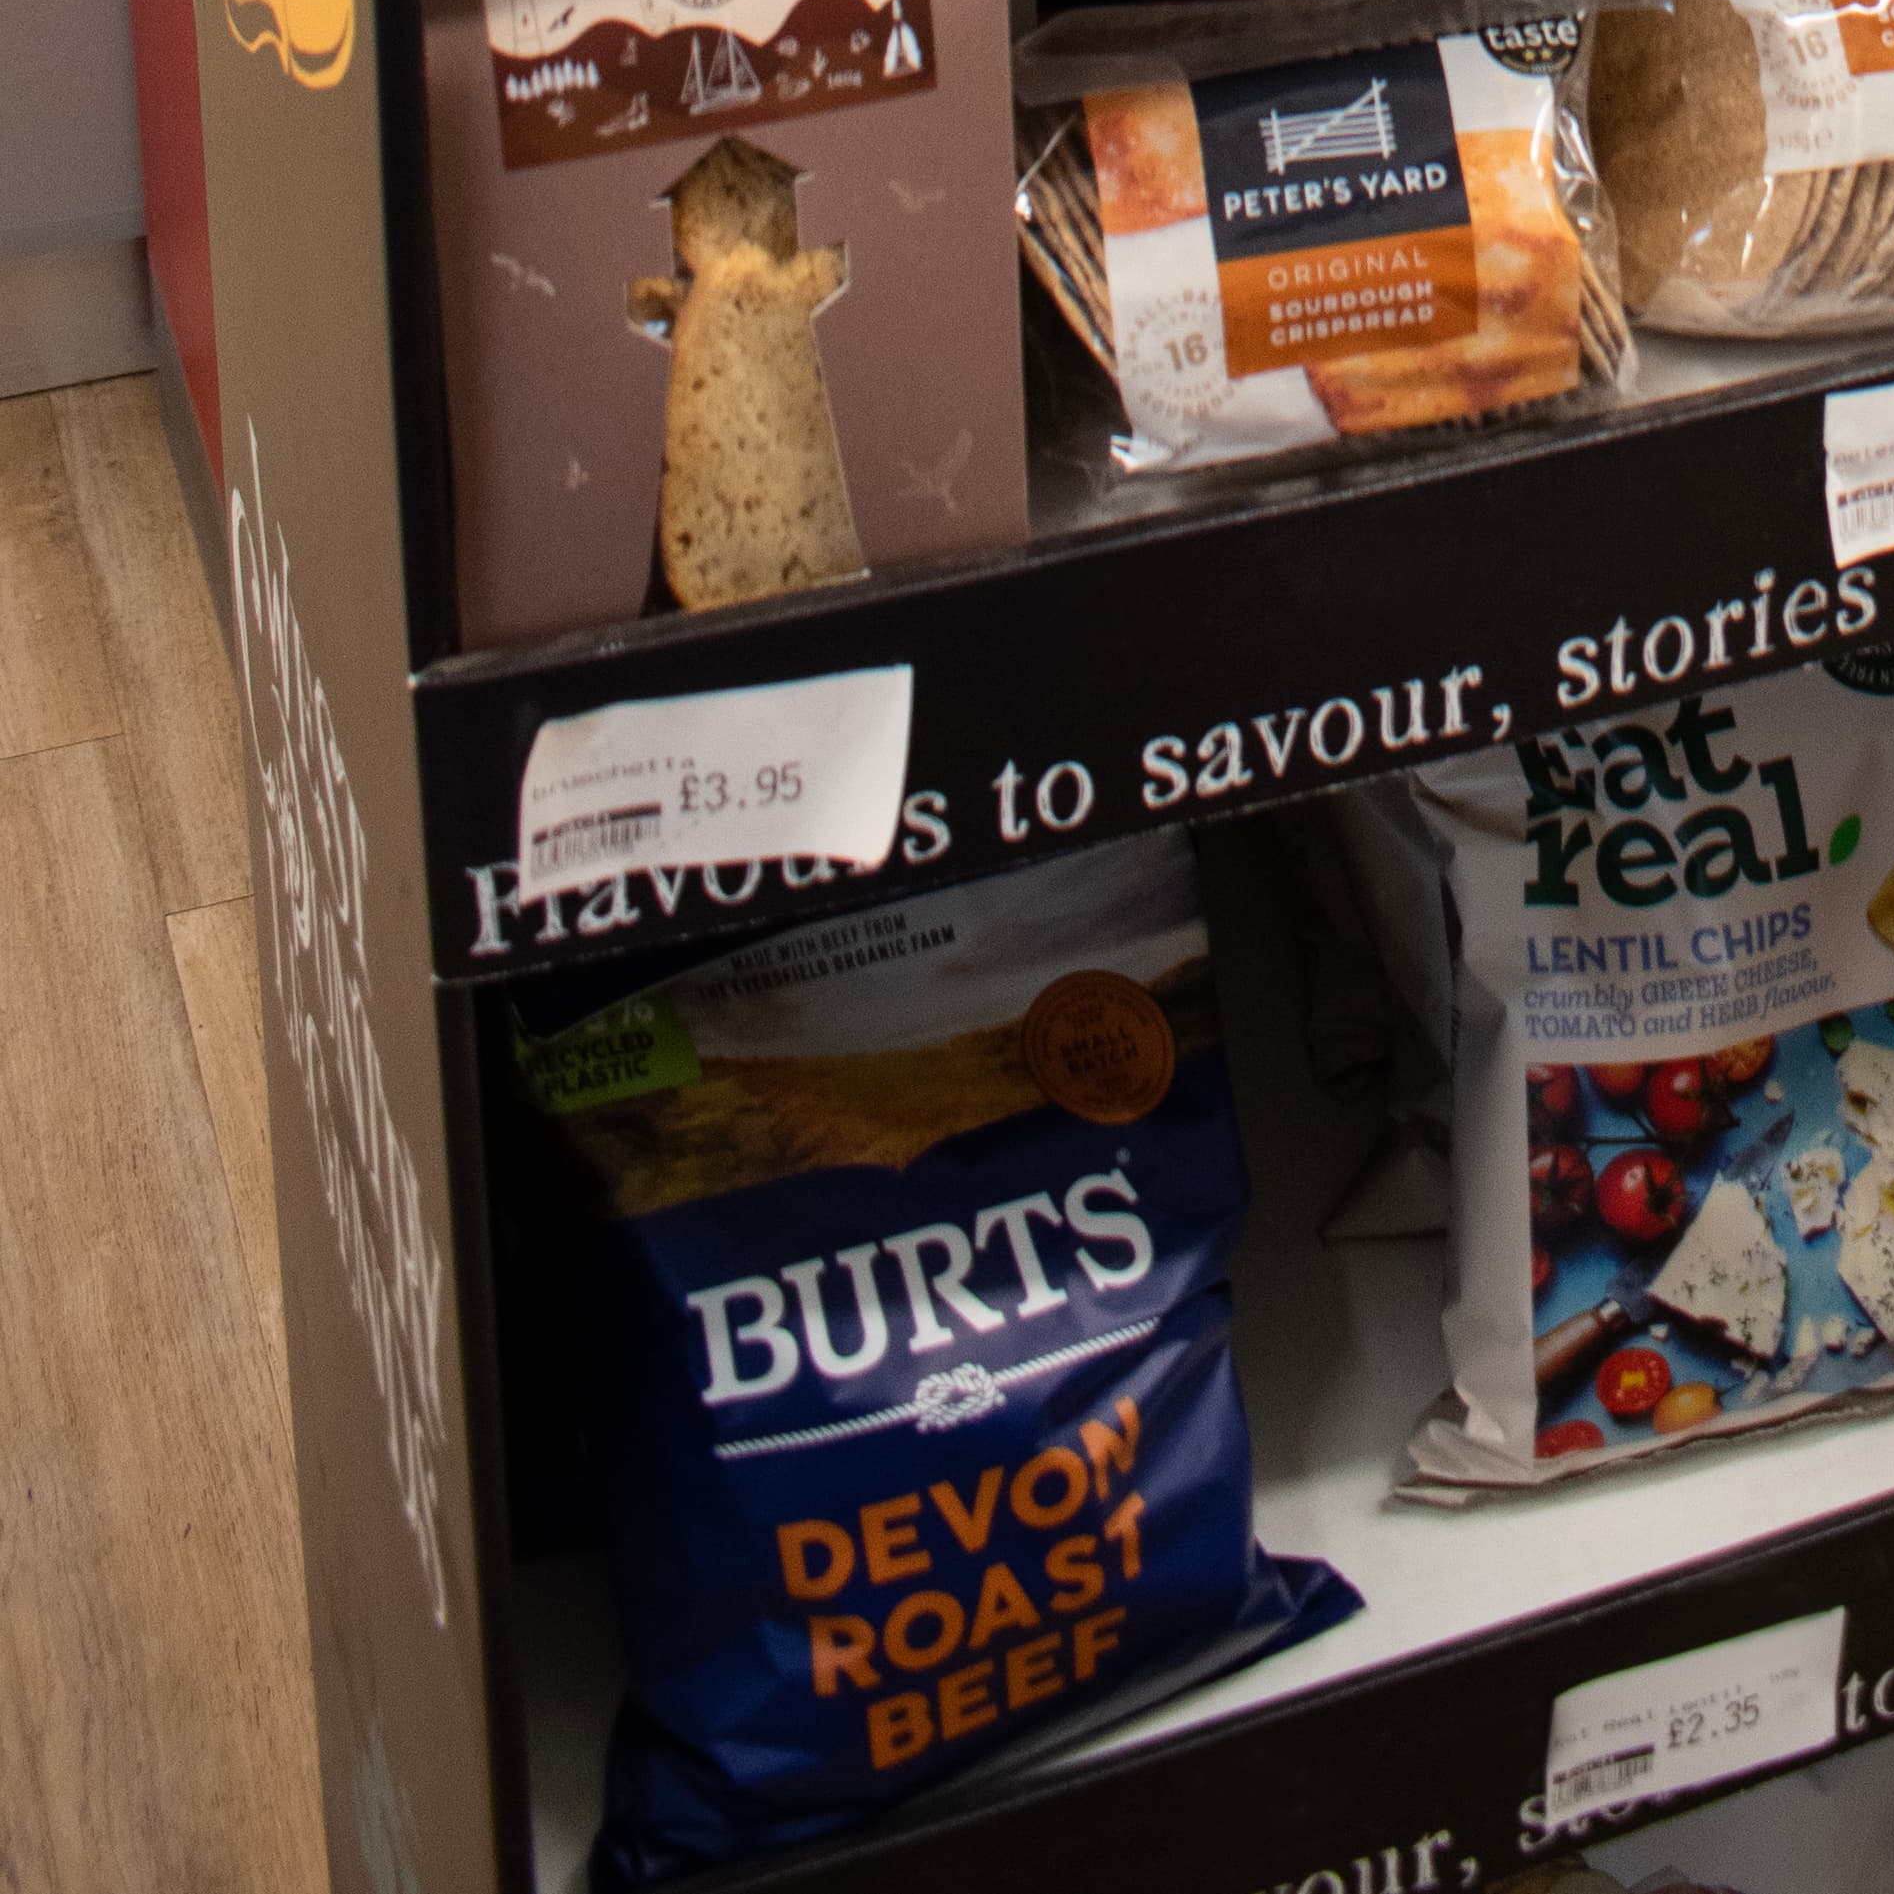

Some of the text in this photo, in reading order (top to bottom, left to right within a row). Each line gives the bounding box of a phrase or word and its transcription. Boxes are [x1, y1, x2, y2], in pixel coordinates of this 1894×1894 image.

[1486, 15, 1577, 51] taste
[1222, 163, 1448, 222] PETER'S YARD
[1266, 247, 1430, 292] ORIGINAL
[1269, 280, 1435, 324] SOURDOUGH
[1269, 304, 1436, 346] CRISPBREAD
[992, 759, 1095, 842] to
[1140, 665, 1514, 808] savour,
[1556, 567, 1878, 708] stories
[1517, 696, 1752, 817] Eat
[678, 762, 802, 814] £3.95
[1522, 757, 1820, 909] real
[1526, 902, 1813, 975] LENTIL CHIPS
[1525, 981, 1633, 1014] crumbly
[1641, 971, 1729, 1007] GREEK
[1525, 1009, 1637, 1040] TOMATO
[1644, 1008, 1691, 1035] and
[1698, 992, 1759, 1032] HERB
[686, 1168, 1156, 1406] BURTS
[775, 1396, 1141, 1602] DEVON
[807, 1494, 1147, 1698] ROAST
[866, 1607, 1126, 1771] BEEF
[1665, 1695, 1762, 1751] £2.35
